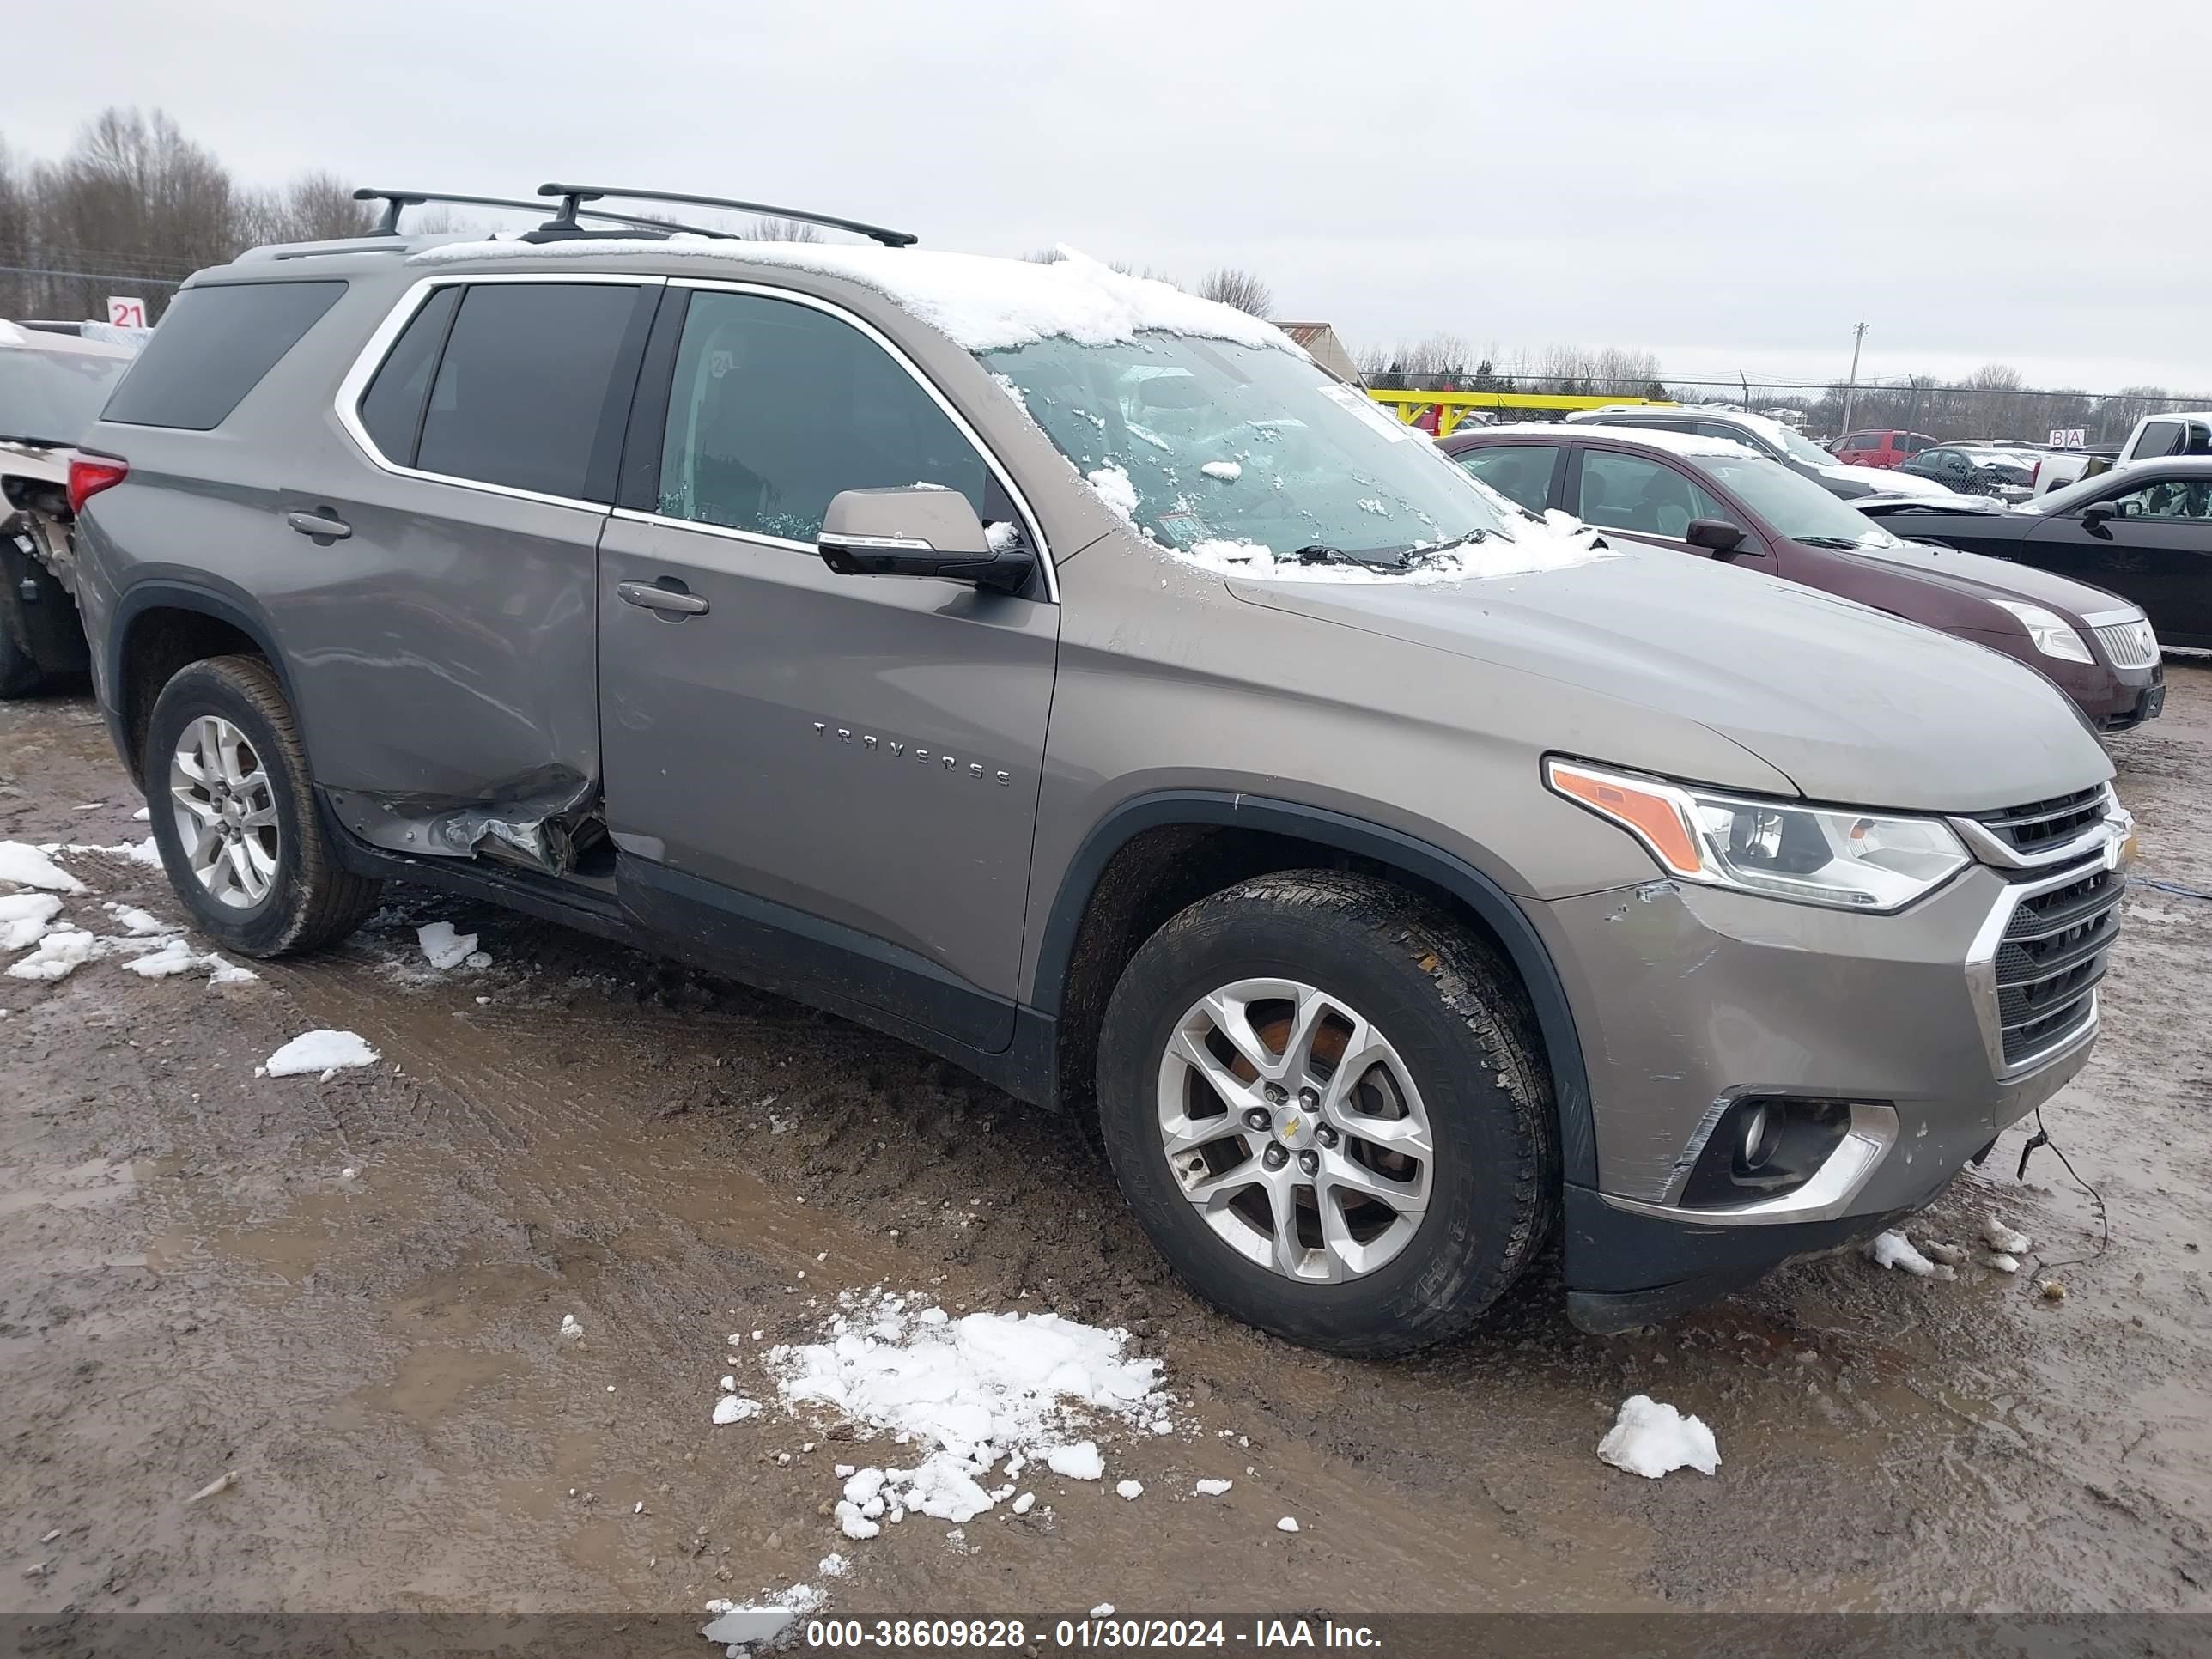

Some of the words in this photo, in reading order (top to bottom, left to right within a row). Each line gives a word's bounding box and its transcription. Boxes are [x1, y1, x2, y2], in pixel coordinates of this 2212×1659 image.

[112, 303, 143, 328] 21
[2053, 431, 2063, 446] B
[2069, 431, 2081, 446] A
[813, 721, 1010, 787] TRAVERSE
